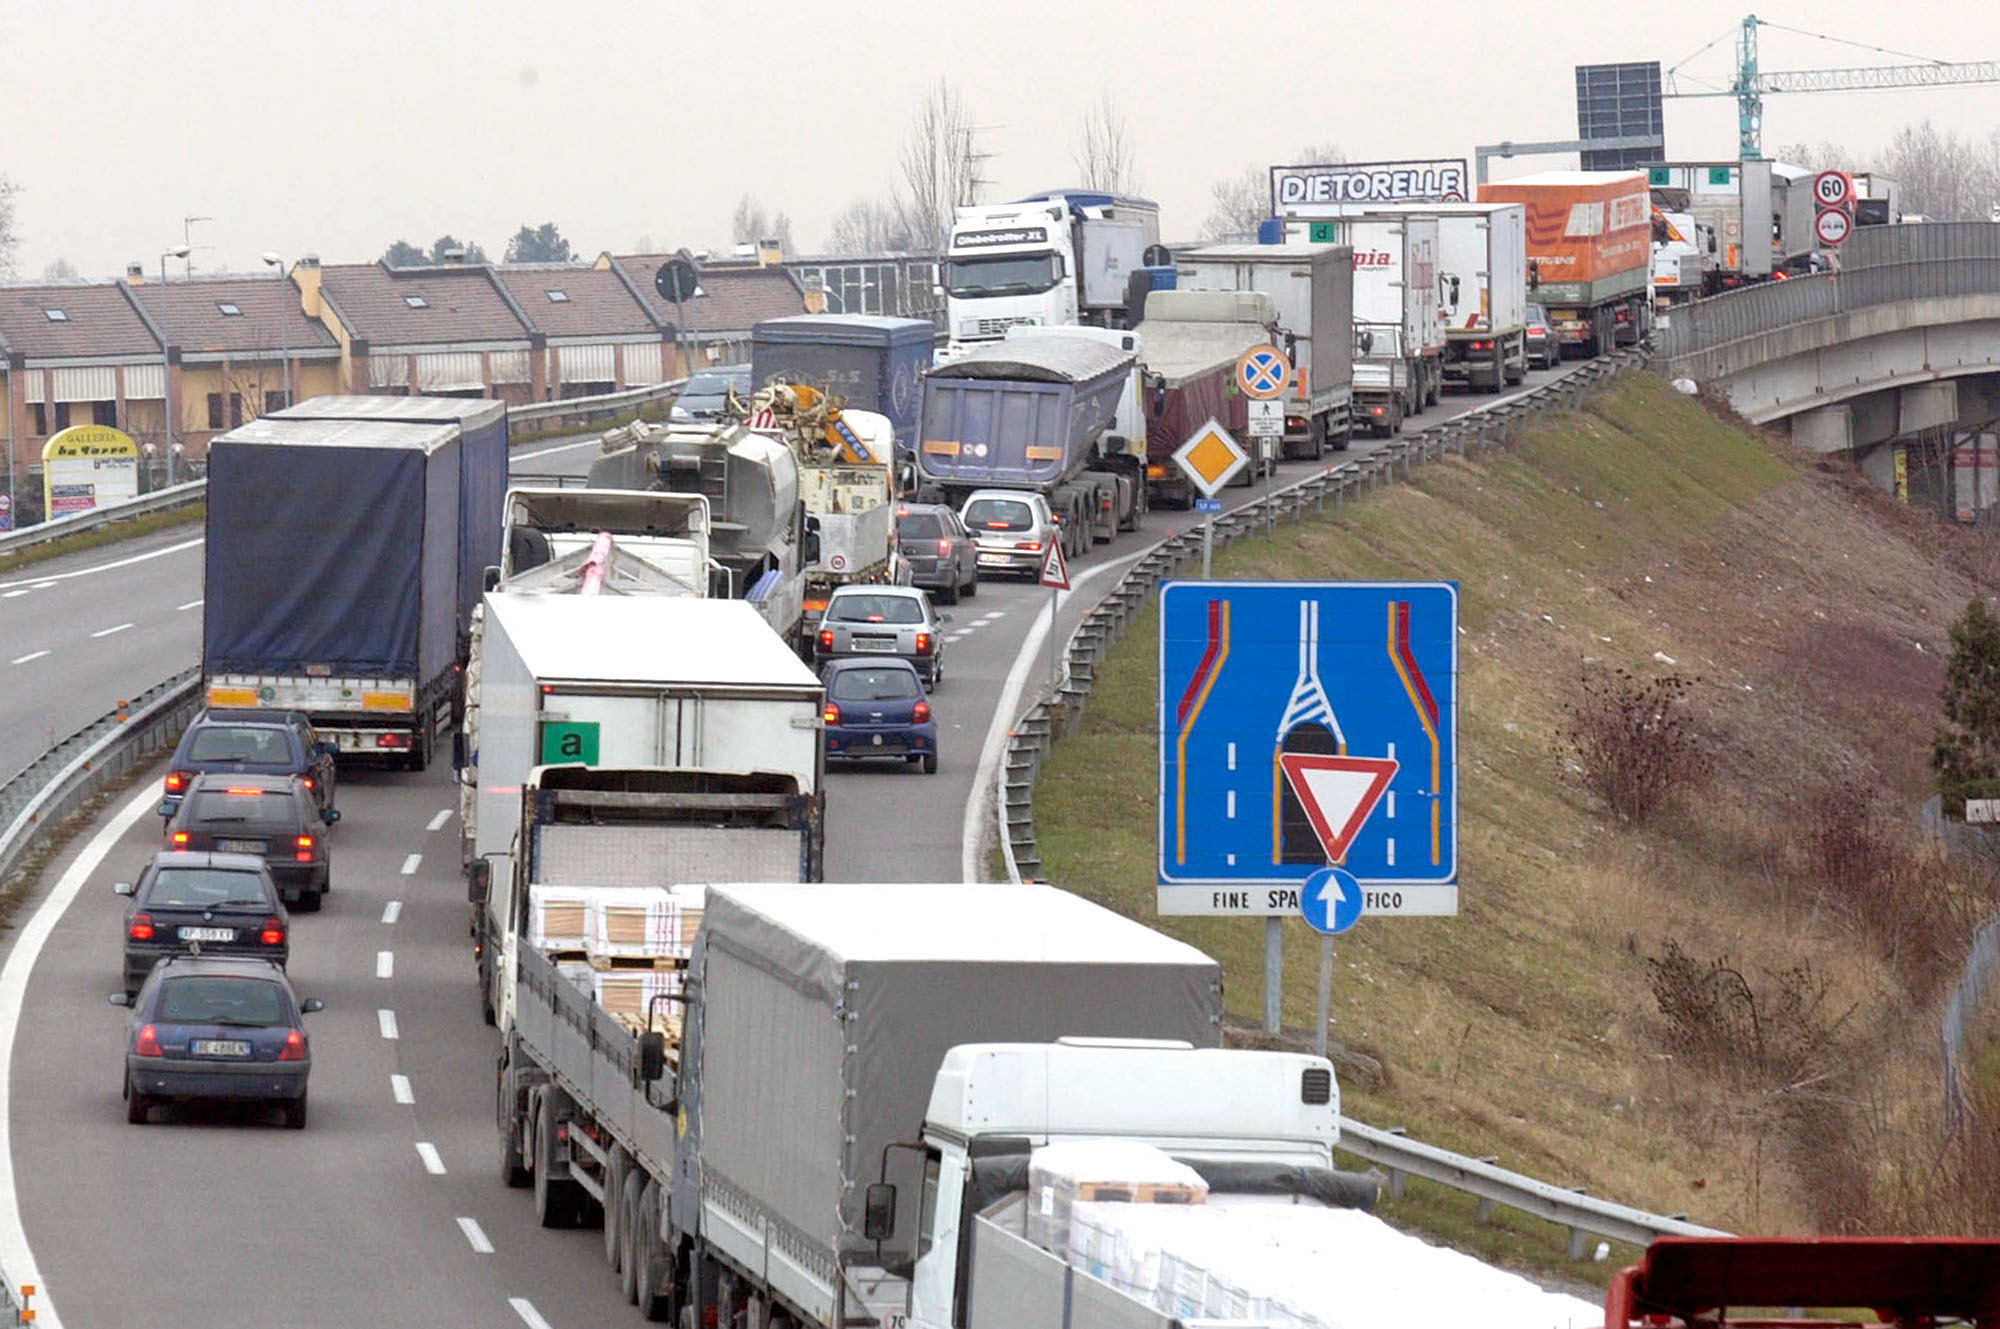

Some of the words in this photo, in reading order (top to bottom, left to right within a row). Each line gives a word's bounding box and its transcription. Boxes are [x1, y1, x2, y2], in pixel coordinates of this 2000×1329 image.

[1281, 169, 1461, 205] DIETORELLE
[1821, 179, 1842, 197] 60
[1027, 231, 1043, 241] XL
[1316, 225, 1327, 239] d
[1352, 248, 1391, 272] pia
[560, 733, 582, 756] a
[1213, 892, 1249, 908] FINE
[1268, 890, 1298, 908] SPA
[1362, 892, 1402, 908] FICO
[890, 1314, 905, 1329] 70
